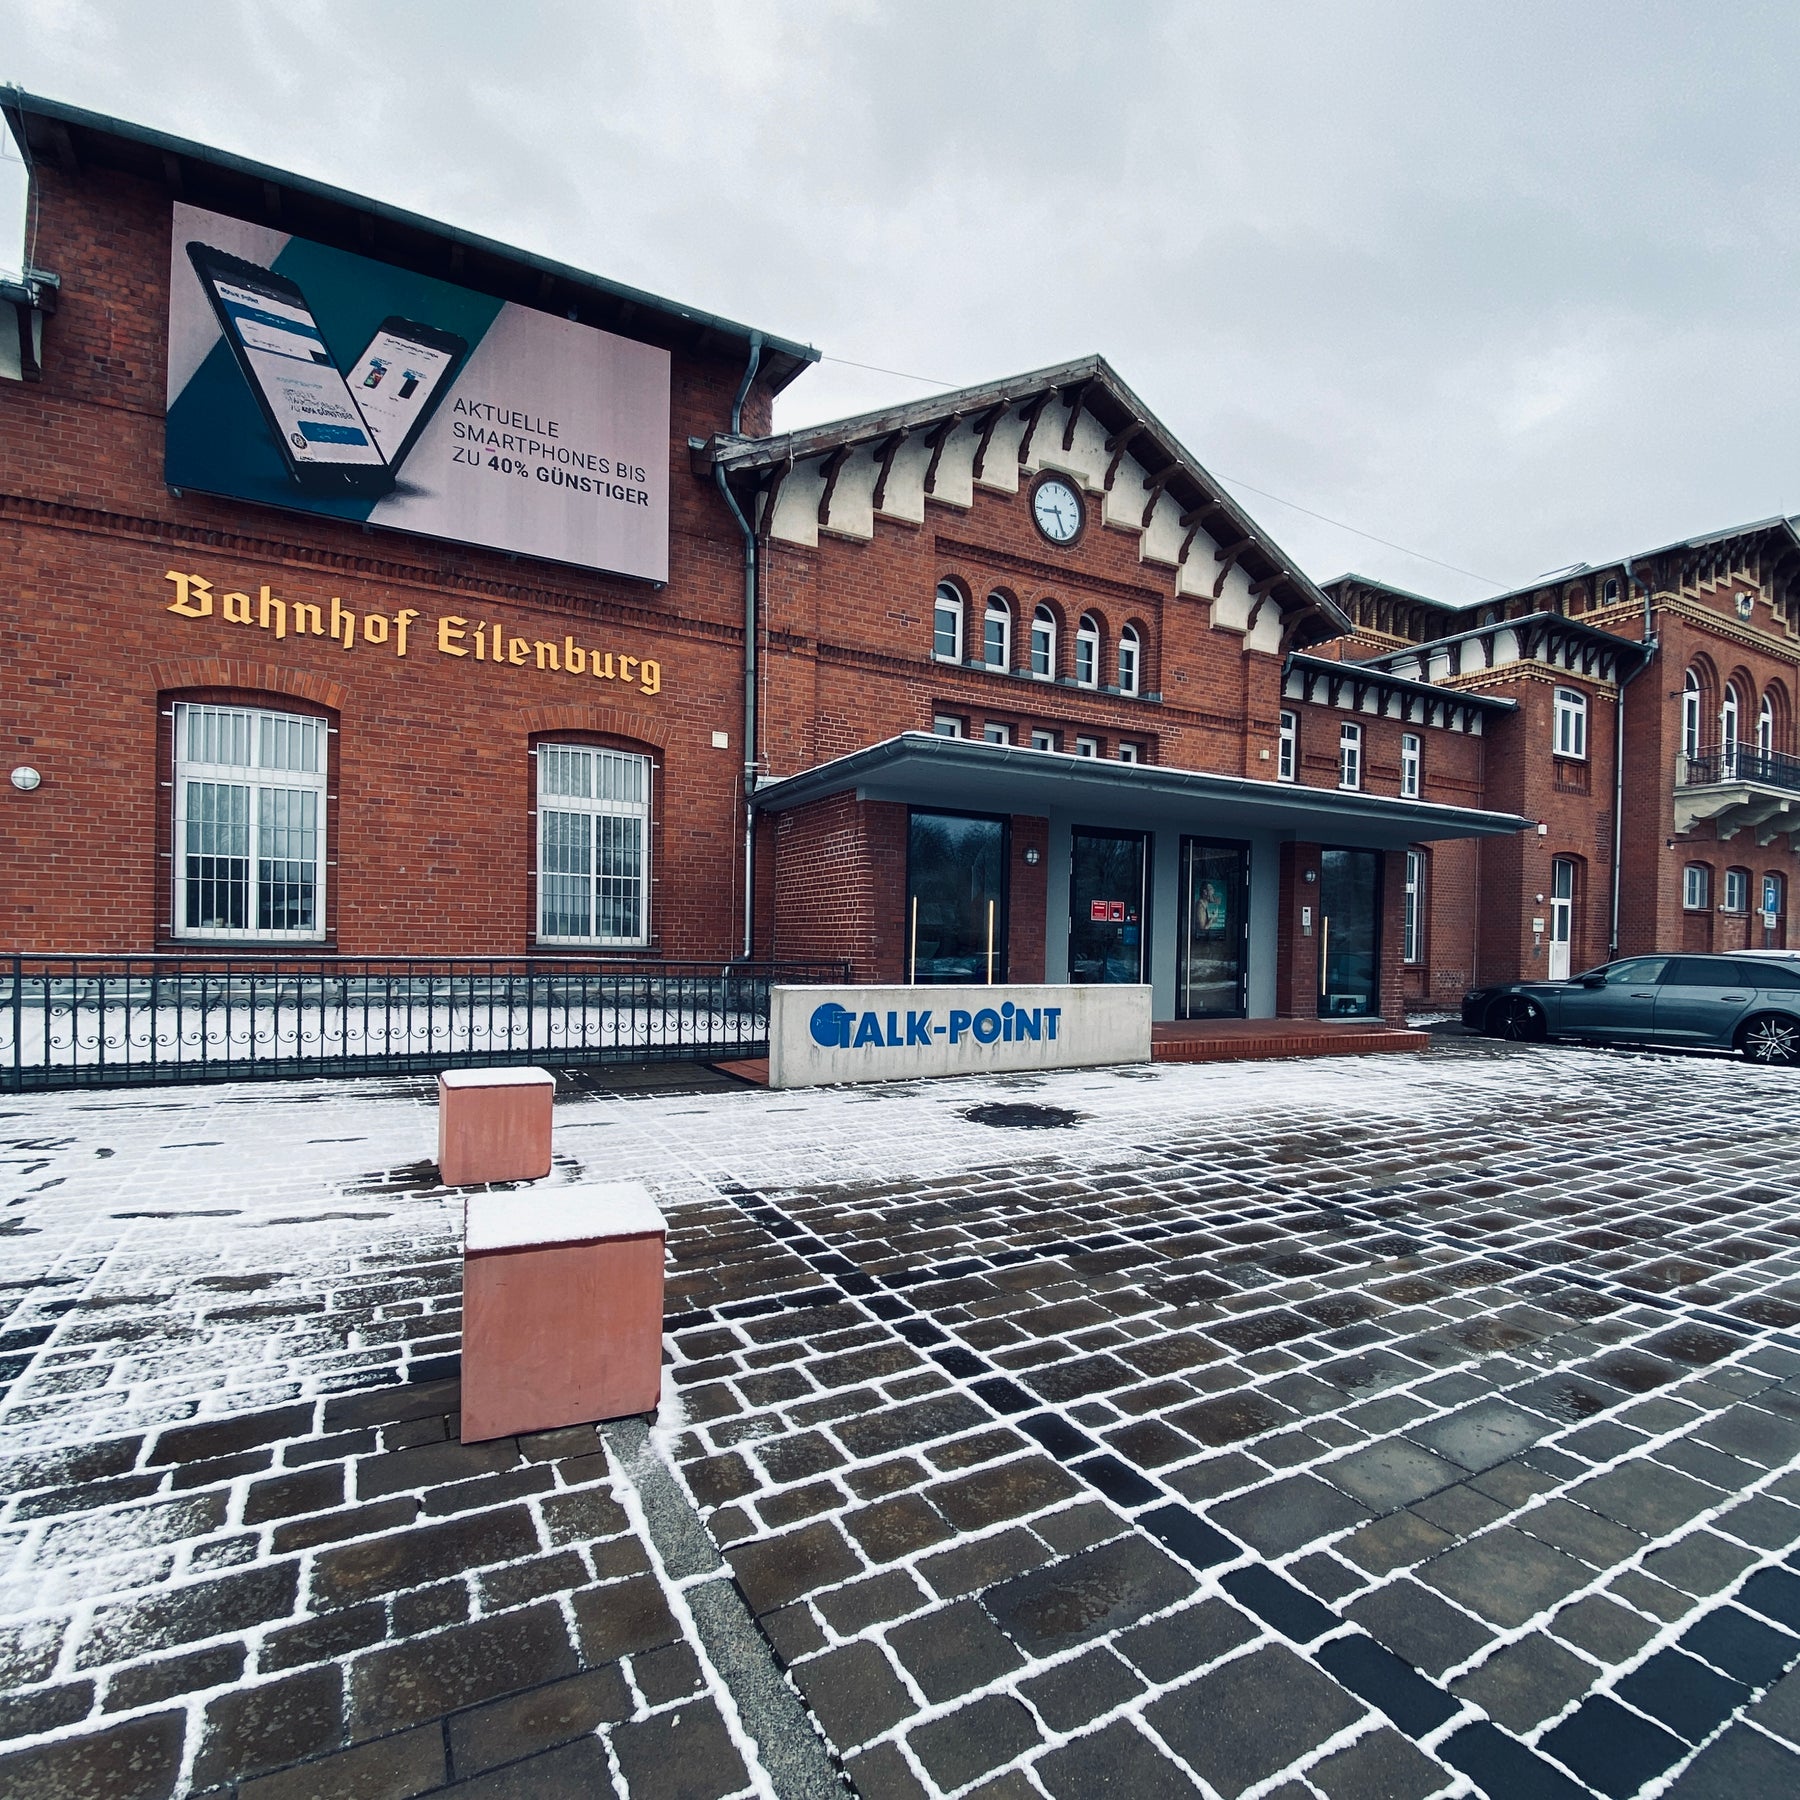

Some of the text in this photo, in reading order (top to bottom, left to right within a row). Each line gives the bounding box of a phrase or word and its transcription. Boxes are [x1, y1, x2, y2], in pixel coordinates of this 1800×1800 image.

[453, 397, 560, 439] AKTUELLE
[452, 421, 647, 484] SMARTPHONES BIS
[452, 445, 649, 507] ZU 40% GÜNSTIGER
[164, 569, 662, 696] Bahnhof Eilenburg
[1768, 892, 1774, 911] P
